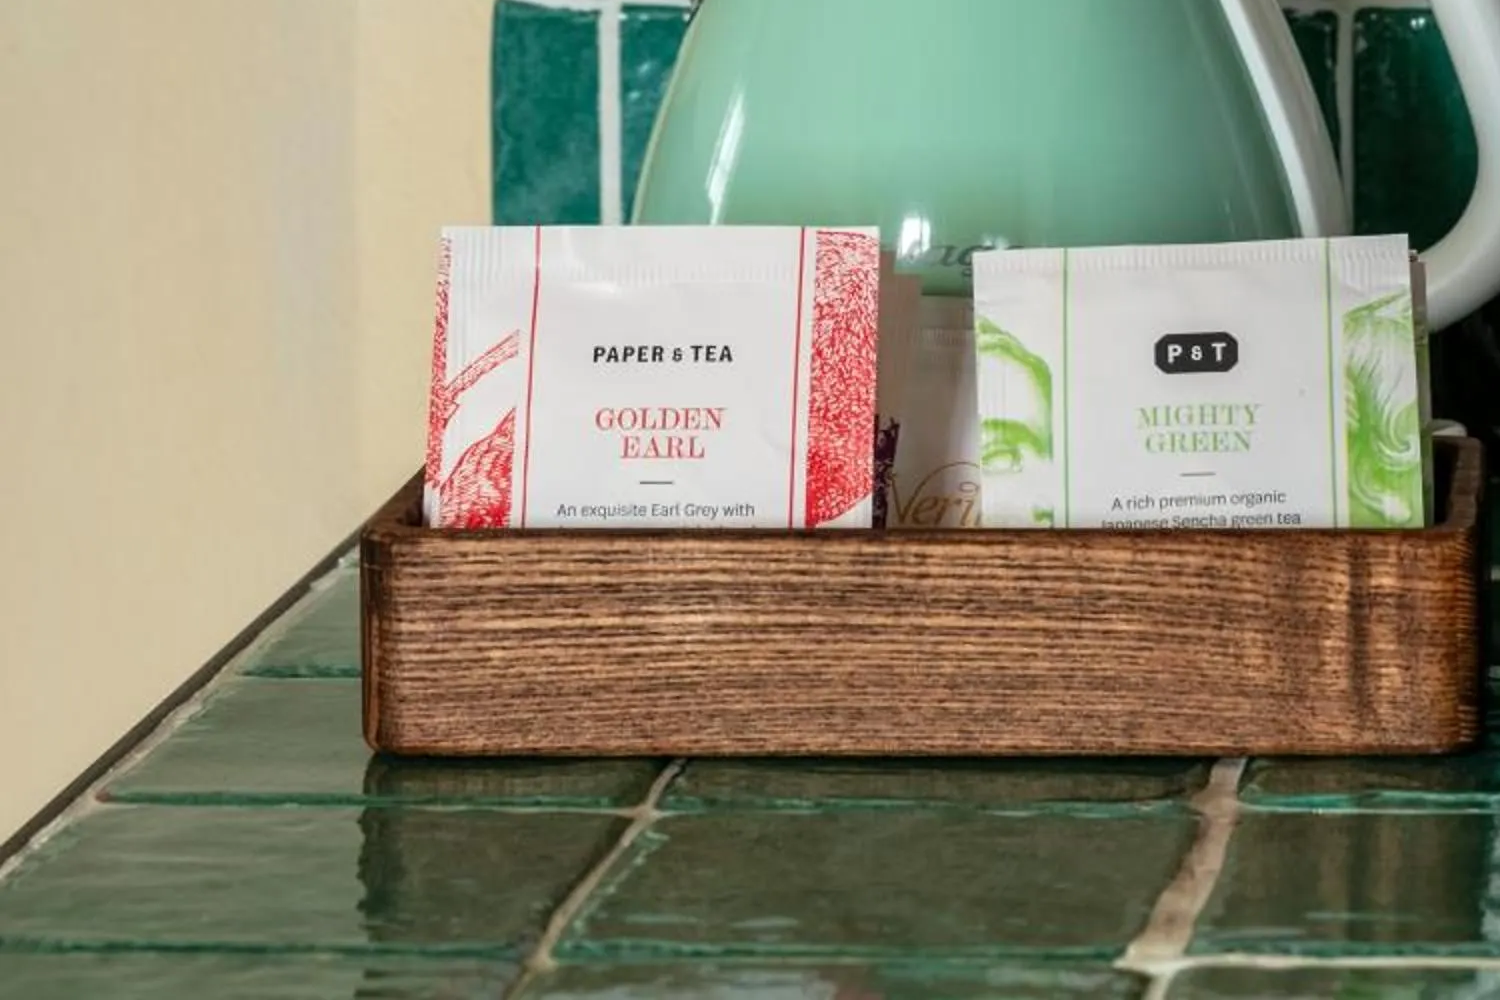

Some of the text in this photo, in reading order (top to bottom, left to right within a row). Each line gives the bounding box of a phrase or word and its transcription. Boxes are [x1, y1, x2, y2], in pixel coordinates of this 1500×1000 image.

[593, 345, 734, 363] PAPER & TEA
[1167, 342, 1227, 364] P & T
[595, 407, 726, 430] GOLDEN
[1136, 403, 1261, 428] MIGHTY
[620, 435, 706, 459] EARL
[1145, 431, 1253, 454] GREEN
[556, 503, 756, 520] An exquisite Earl Grey with
[1111, 490, 1288, 512] A rich premium organic
[1172, 514, 1227, 528] Sencha
[1231, 515, 1274, 528] green
[1277, 512, 1302, 525] tea
